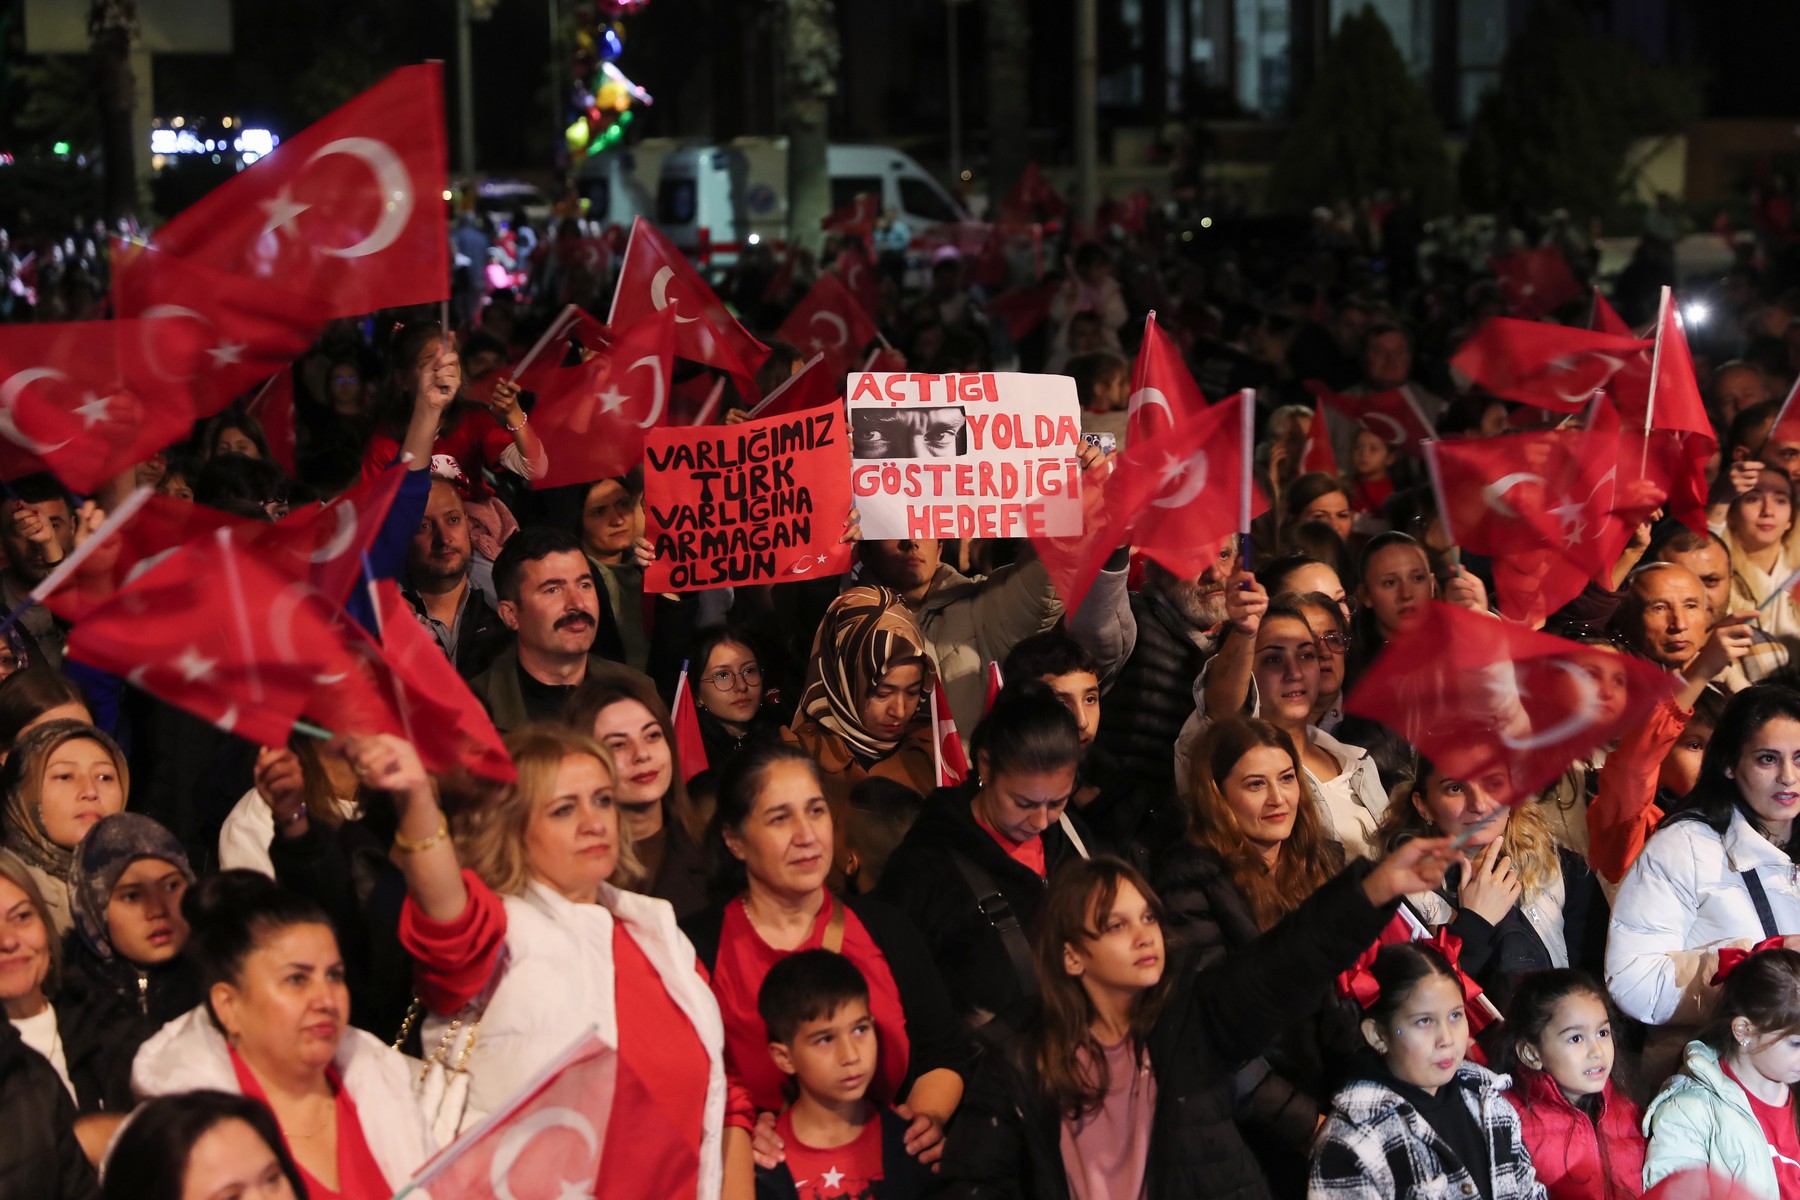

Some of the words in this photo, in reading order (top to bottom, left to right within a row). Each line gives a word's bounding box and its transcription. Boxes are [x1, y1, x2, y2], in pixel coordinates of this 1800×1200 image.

[851, 372, 999, 407] AÇTIĞI
[647, 412, 834, 472] VARLIĞIMIZ
[965, 413, 1079, 450] YOLDA
[690, 457, 795, 502] TÜRK
[853, 458, 1079, 499] GÖSTERDİĞİ
[651, 486, 813, 531] VARLIĞINA
[907, 503, 1046, 538] HEDEFE
[655, 516, 811, 563] ARMAĞAN
[669, 551, 776, 588] OLSUN
